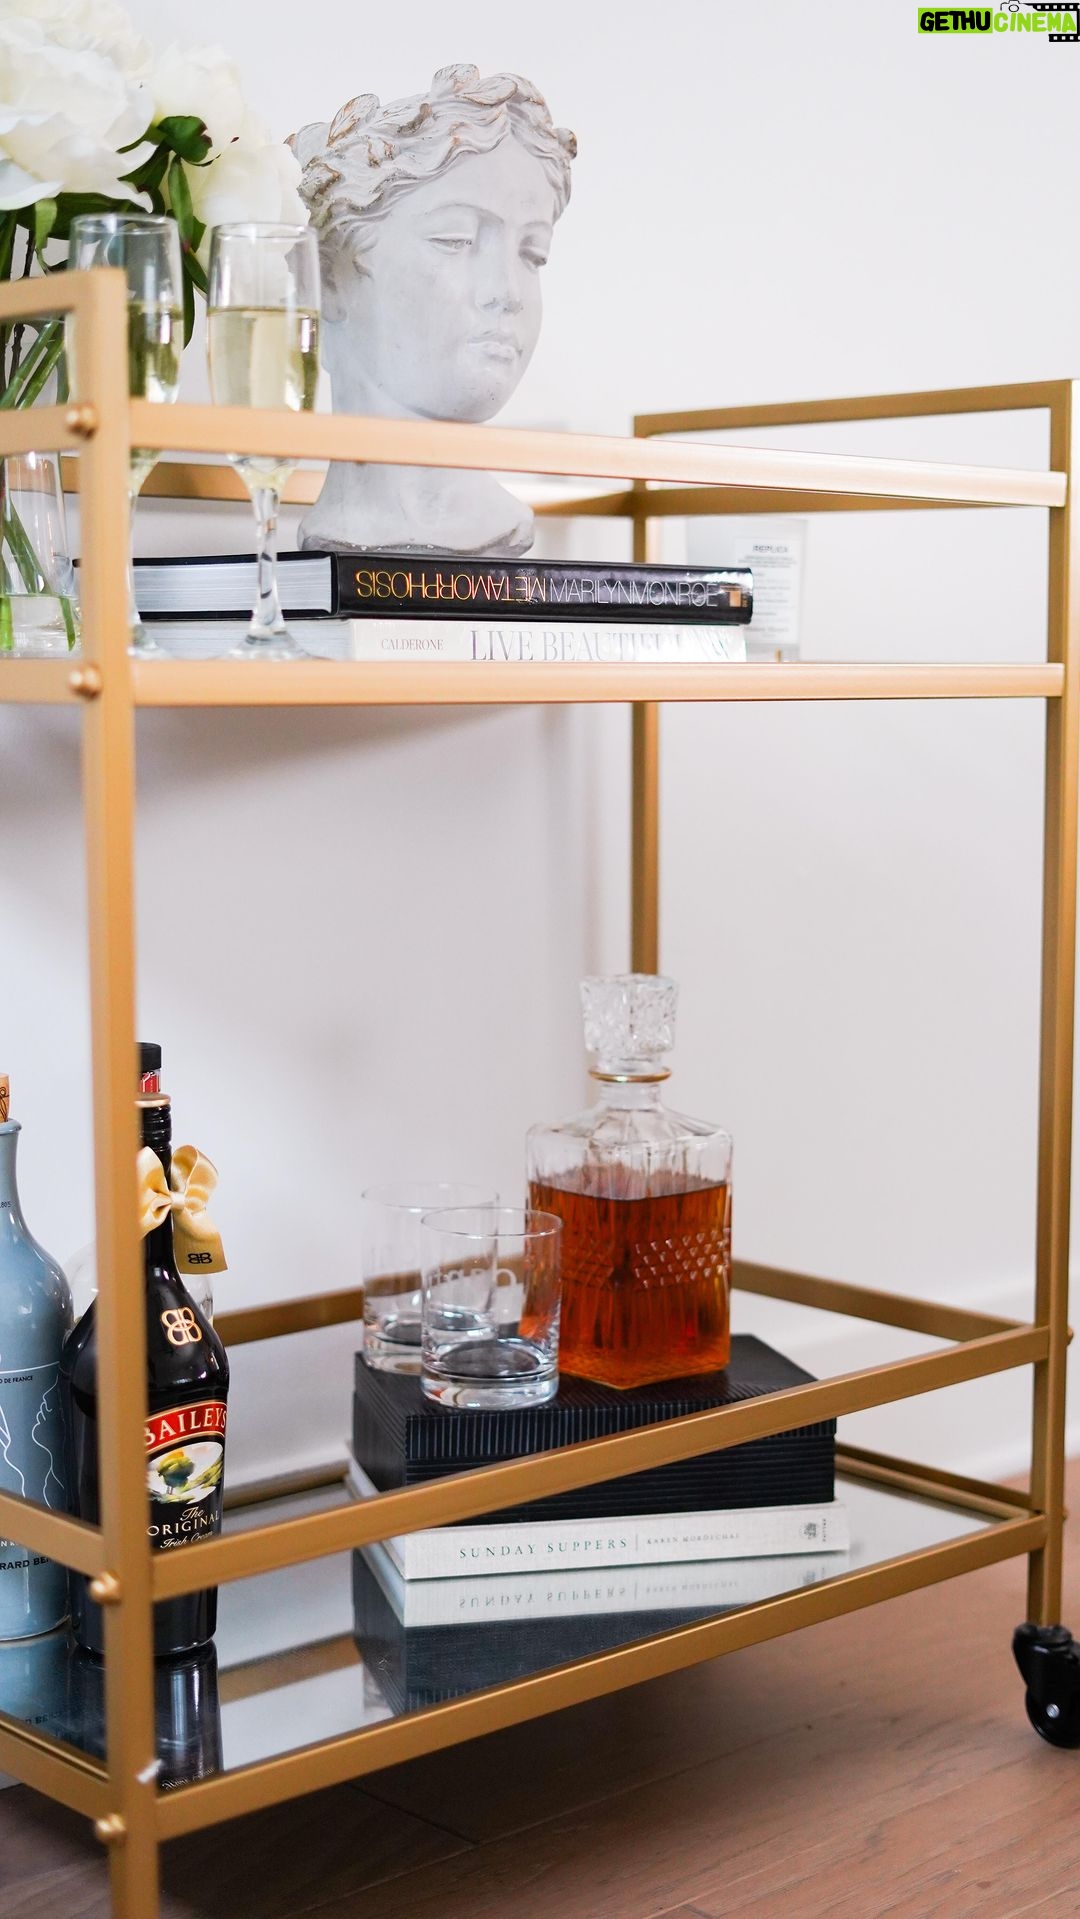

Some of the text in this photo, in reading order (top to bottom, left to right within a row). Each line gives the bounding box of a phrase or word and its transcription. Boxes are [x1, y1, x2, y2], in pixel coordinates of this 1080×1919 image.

[355, 570, 546, 602] METAMORPHOSIS
[381, 638, 443, 651] CALDERONE
[470, 630, 534, 661] LIVE
[147, 1510, 219, 1536] ORIGINAL
[180, 1506, 204, 1521] The
[160, 1536, 187, 1549] Irish
[459, 1537, 628, 1559] SUNDAY SUPPERS
